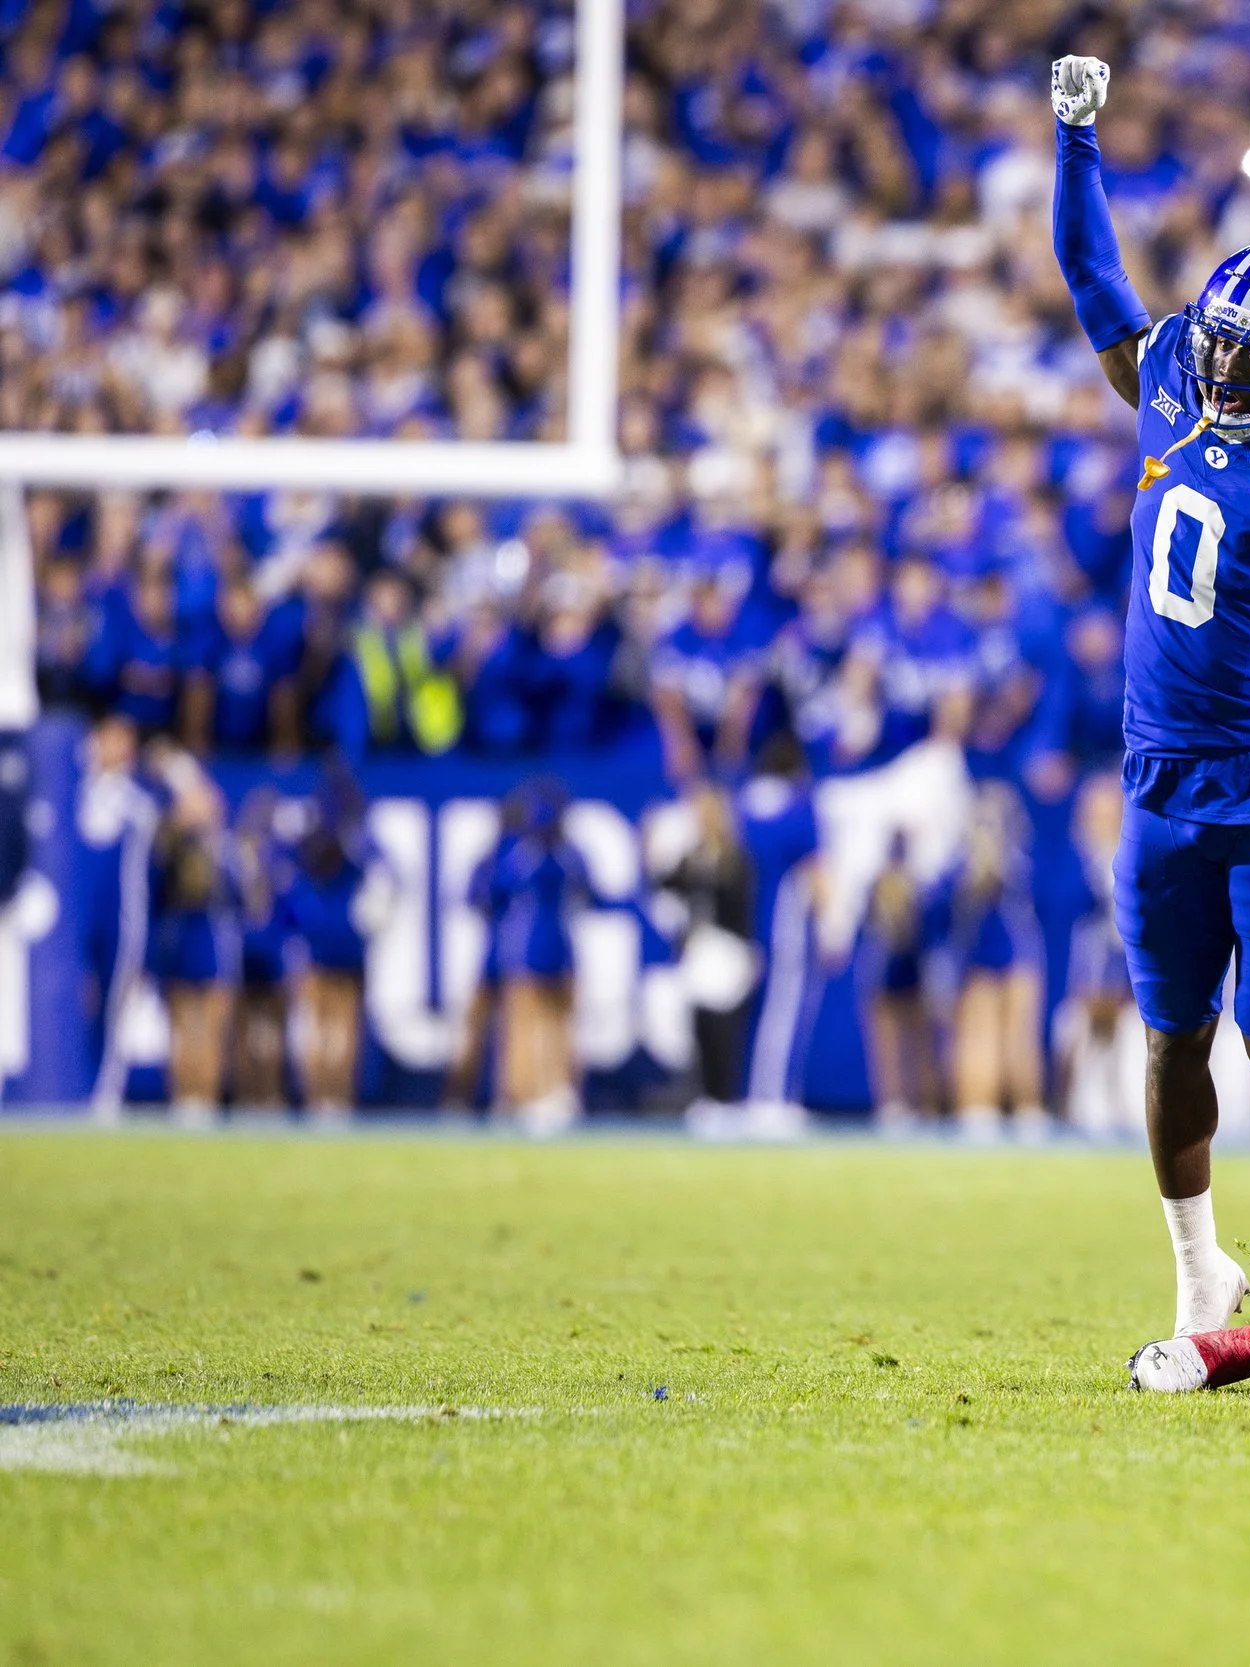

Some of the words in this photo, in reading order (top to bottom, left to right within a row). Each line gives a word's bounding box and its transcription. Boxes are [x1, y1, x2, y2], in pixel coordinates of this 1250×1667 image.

[1151, 385, 1182, 427] XII
[1210, 449, 1225, 465] Y
[1148, 483, 1227, 629] 0
